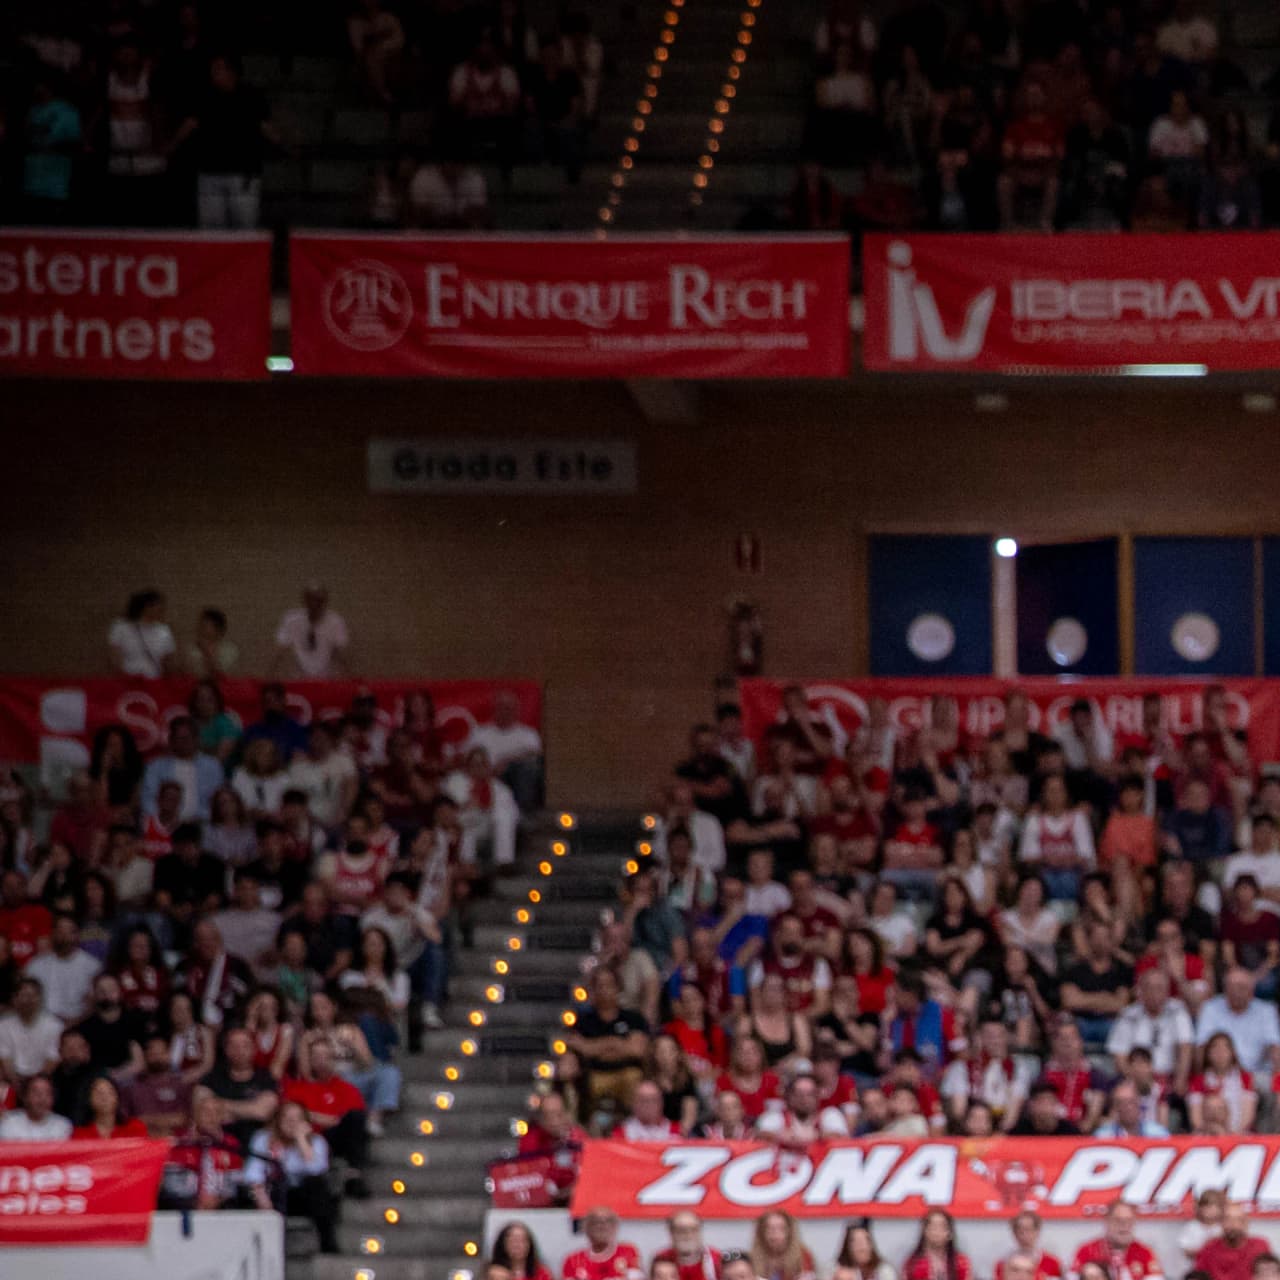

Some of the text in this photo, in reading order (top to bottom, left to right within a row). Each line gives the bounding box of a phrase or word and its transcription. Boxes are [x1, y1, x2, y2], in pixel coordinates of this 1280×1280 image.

[668, 263, 807, 328] RECH
[1010, 279, 1211, 319] IBERIA
[392, 451, 518, 481] Grada
[636, 1144, 960, 1206] ZONA
